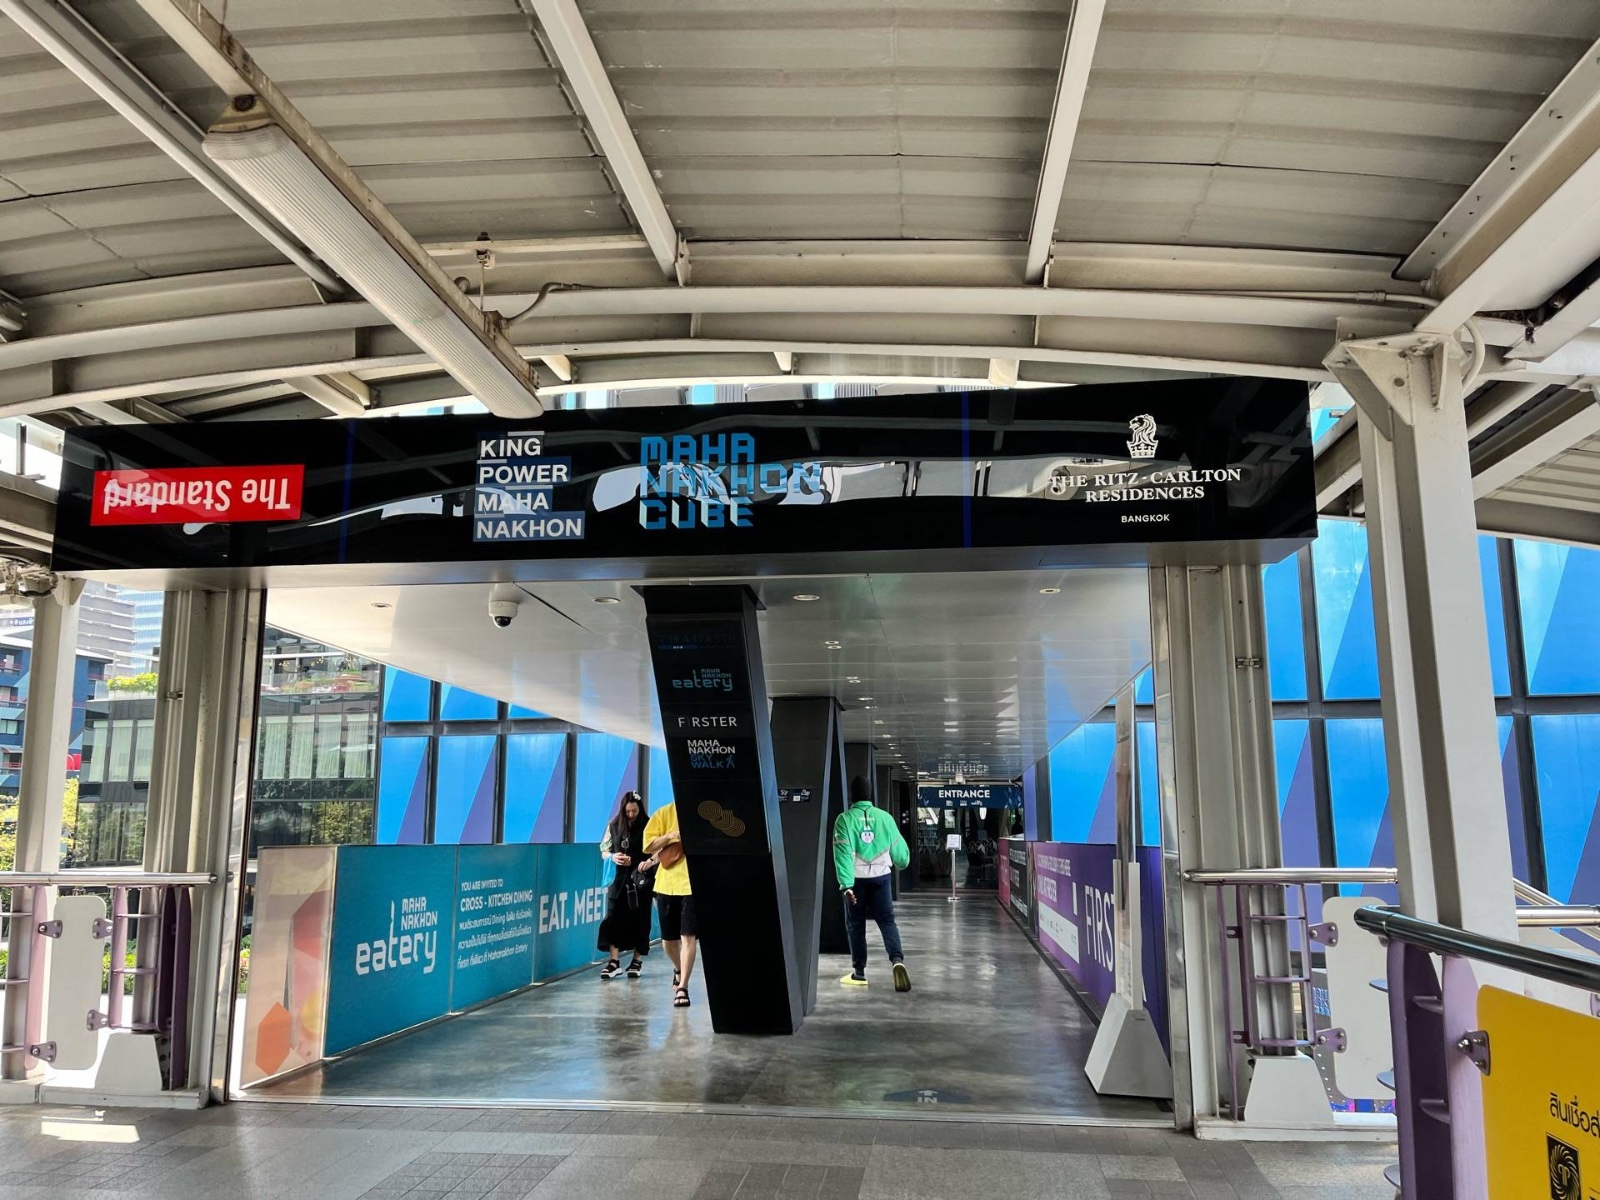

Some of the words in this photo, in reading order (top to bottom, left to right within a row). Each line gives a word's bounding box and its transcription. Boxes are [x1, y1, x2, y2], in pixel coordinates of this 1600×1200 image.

[480, 437, 542, 459] KING
[640, 433, 755, 464] MAHA
[478, 464, 568, 485] POWER
[640, 462, 822, 498] NAKHON
[1050, 475, 1088, 488] THE
[103, 478, 233, 515] Standard
[241, 477, 291, 511] The
[477, 491, 549, 513] MAHA
[1085, 486, 1205, 503] RESIDENCES
[639, 497, 754, 530] CUBE
[1121, 513, 1170, 523] BANGKOK
[476, 517, 583, 539] NAKHON
[672, 669, 733, 691] eatery
[687, 739, 720, 748] MAHA
[688, 746, 736, 754] NAKHON
[690, 753, 713, 761] SKY
[691, 760, 724, 769] WALK
[938, 789, 991, 799] ENTRANCE
[461, 881, 472, 892] YOU
[472, 880, 481, 891] ARE
[401, 896, 427, 912] MAHA
[460, 896, 484, 912] CROSS
[488, 892, 513, 908] KITCHEN
[513, 890, 533, 904] DINING
[401, 911, 438, 931] NAKHON
[538, 891, 570, 935] EAT.
[355, 899, 438, 976] eatery
